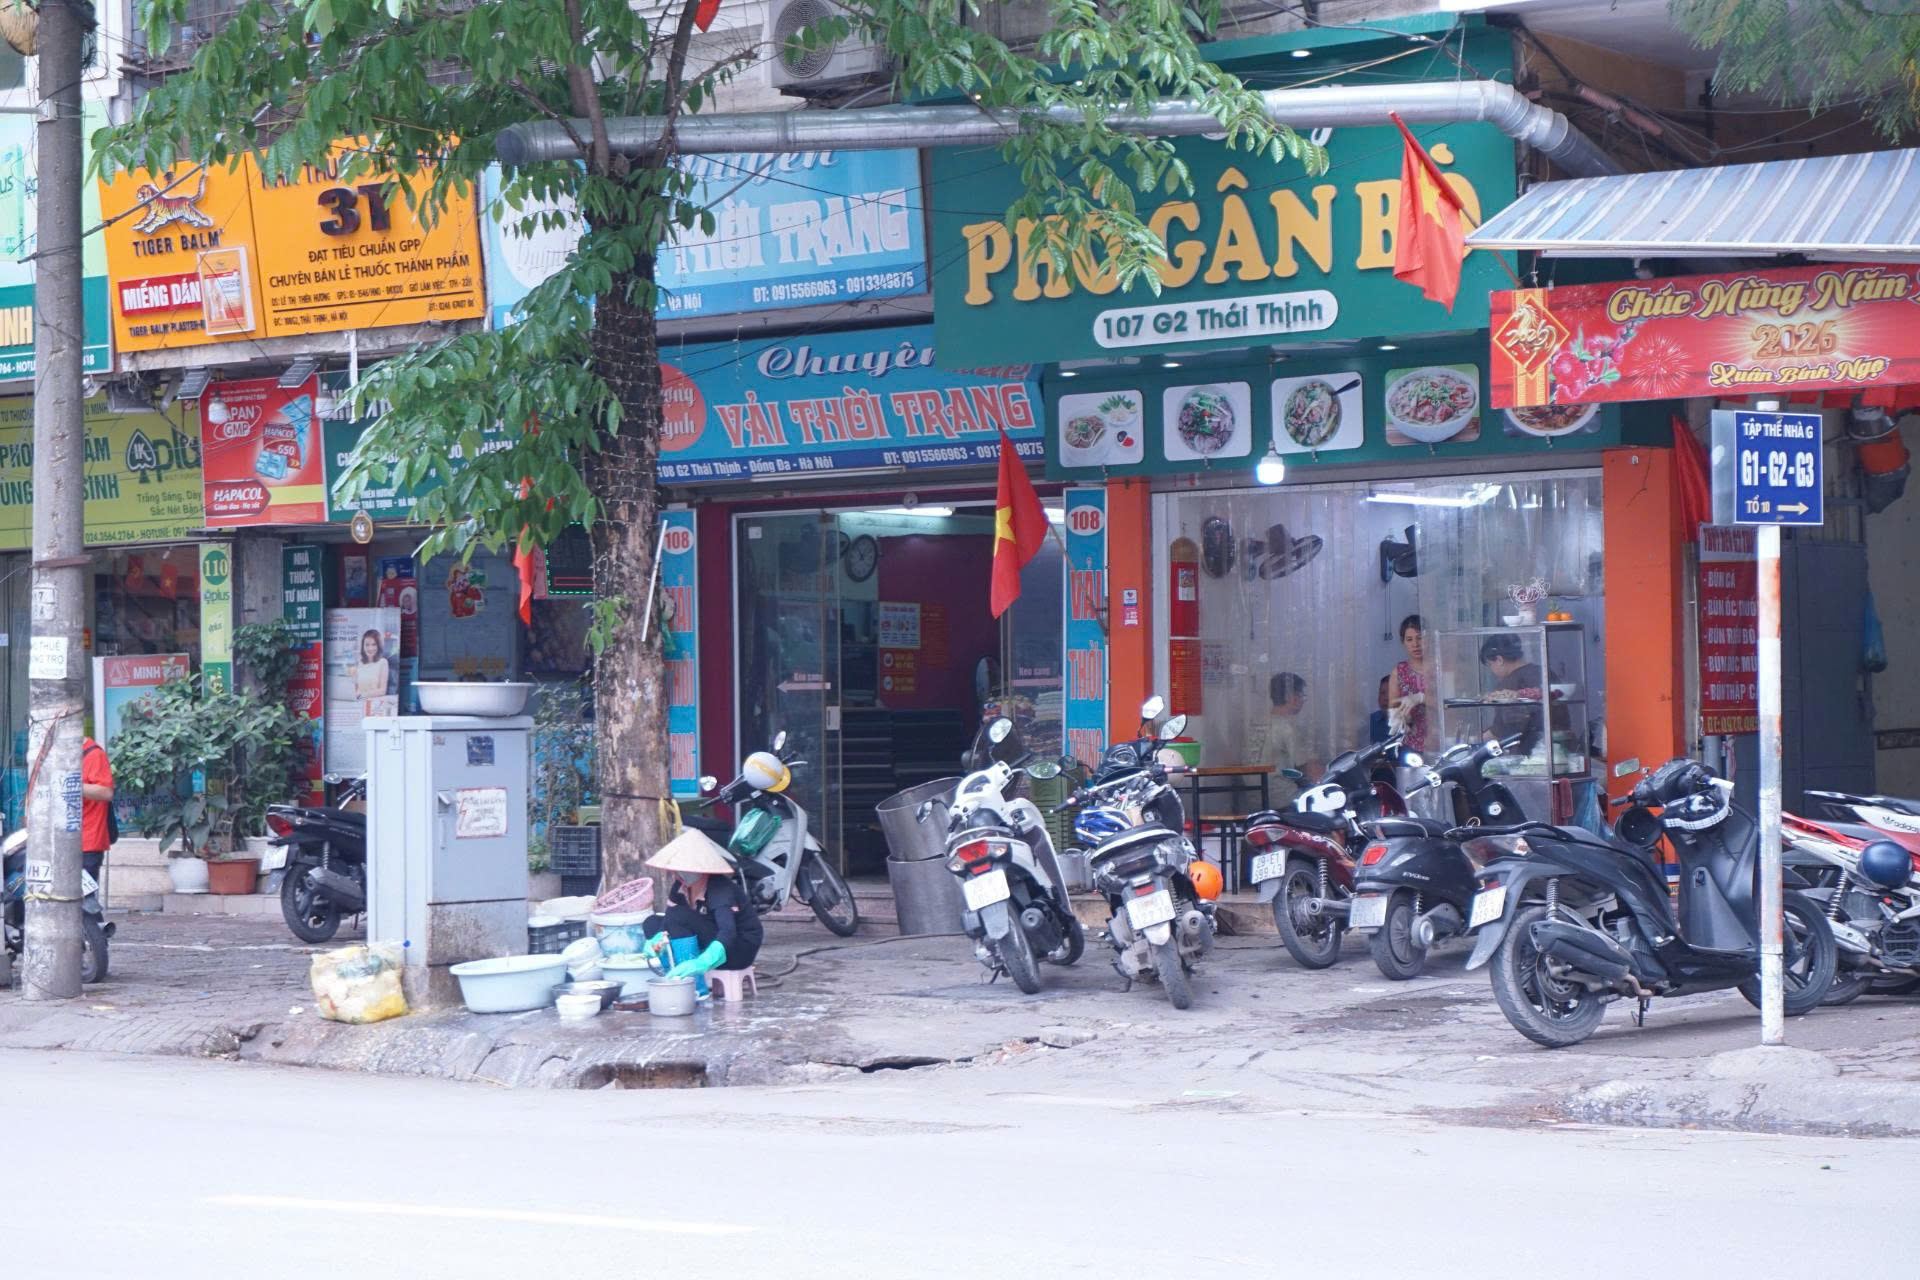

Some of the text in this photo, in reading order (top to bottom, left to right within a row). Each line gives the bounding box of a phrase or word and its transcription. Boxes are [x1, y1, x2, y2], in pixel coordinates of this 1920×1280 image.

[318, 183, 397, 236] 3T
[769, 188, 910, 266] TRANG
[1148, 166, 1337, 289] GÂN
[133, 230, 221, 257] TIGER BALM
[308, 236, 421, 264] ĐẠT TIÊU CHUẨN GPP
[269, 250, 470, 288] CHUYÊN BÁN LẺ THUỐC THÀNH PHẨM
[122, 278, 202, 311] MIẾNG DÁN
[753, 287, 770, 303] ĐT:
[772, 279, 837, 301] 0915566963
[1607, 266, 1908, 323] Chúc Mừng Năm
[1103, 299, 1323, 339] 107 G2 Thái Thịnh
[1751, 321, 1839, 360] 2026
[1709, 358, 1774, 387] Xuân
[1835, 354, 1892, 384] Ngọ
[226, 405, 255, 421] APAN
[713, 382, 1036, 448] VẢI THỜI TRANG
[1743, 417, 1762, 440] TẬP
[1783, 420, 1804, 438] NHÀ
[1805, 425, 1813, 439] G
[676, 464, 690, 476] G2
[690, 462, 712, 476] Thái
[714, 460, 741, 477] Thịnh
[750, 458, 775, 473] Đống
[777, 458, 791, 471] Đa
[799, 457, 813, 470] Hà
[815, 455, 833, 469] Nội
[884, 442, 1044, 465] ĐT: 0915566963 09139875
[1071, 510, 1100, 530] 108
[1761, 501, 1770, 513] 10
[664, 531, 689, 550] 108
[204, 559, 227, 577] 110
[293, 552, 309, 565] NHÀ
[297, 606, 307, 619] 3T
[133, 665, 160, 680] MINH
[1068, 640, 1102, 700] THỜI
